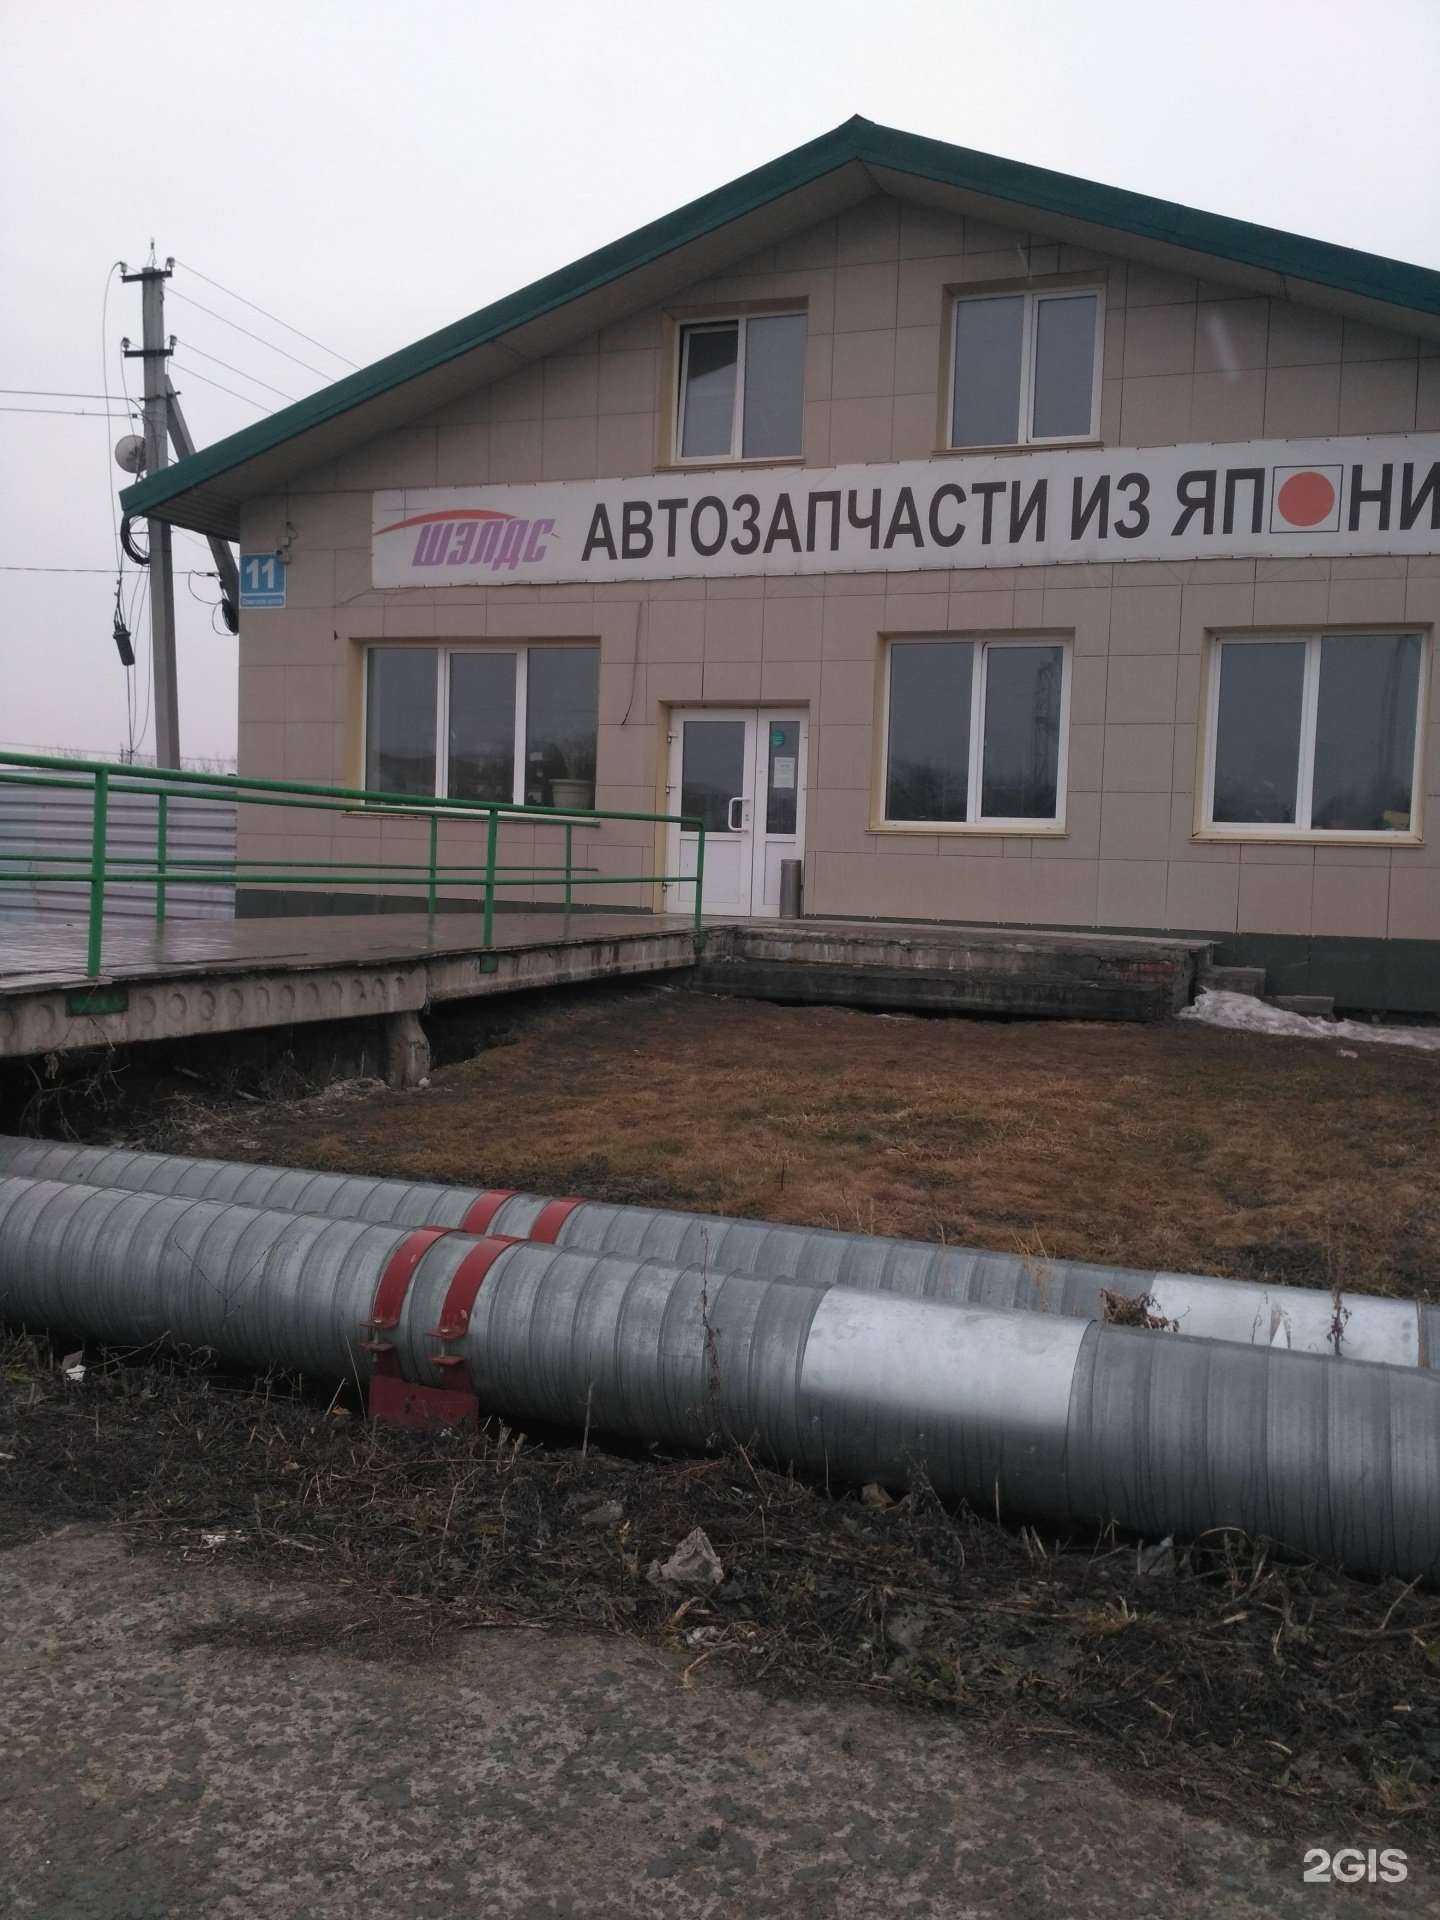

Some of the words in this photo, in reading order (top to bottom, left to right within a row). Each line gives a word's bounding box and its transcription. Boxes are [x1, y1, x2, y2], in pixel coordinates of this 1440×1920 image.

[581, 478, 1048, 562] АВТОЗАПЧАСТИ
[1070, 471, 1151, 541] ИЗ
[246, 558, 275, 590] 11
